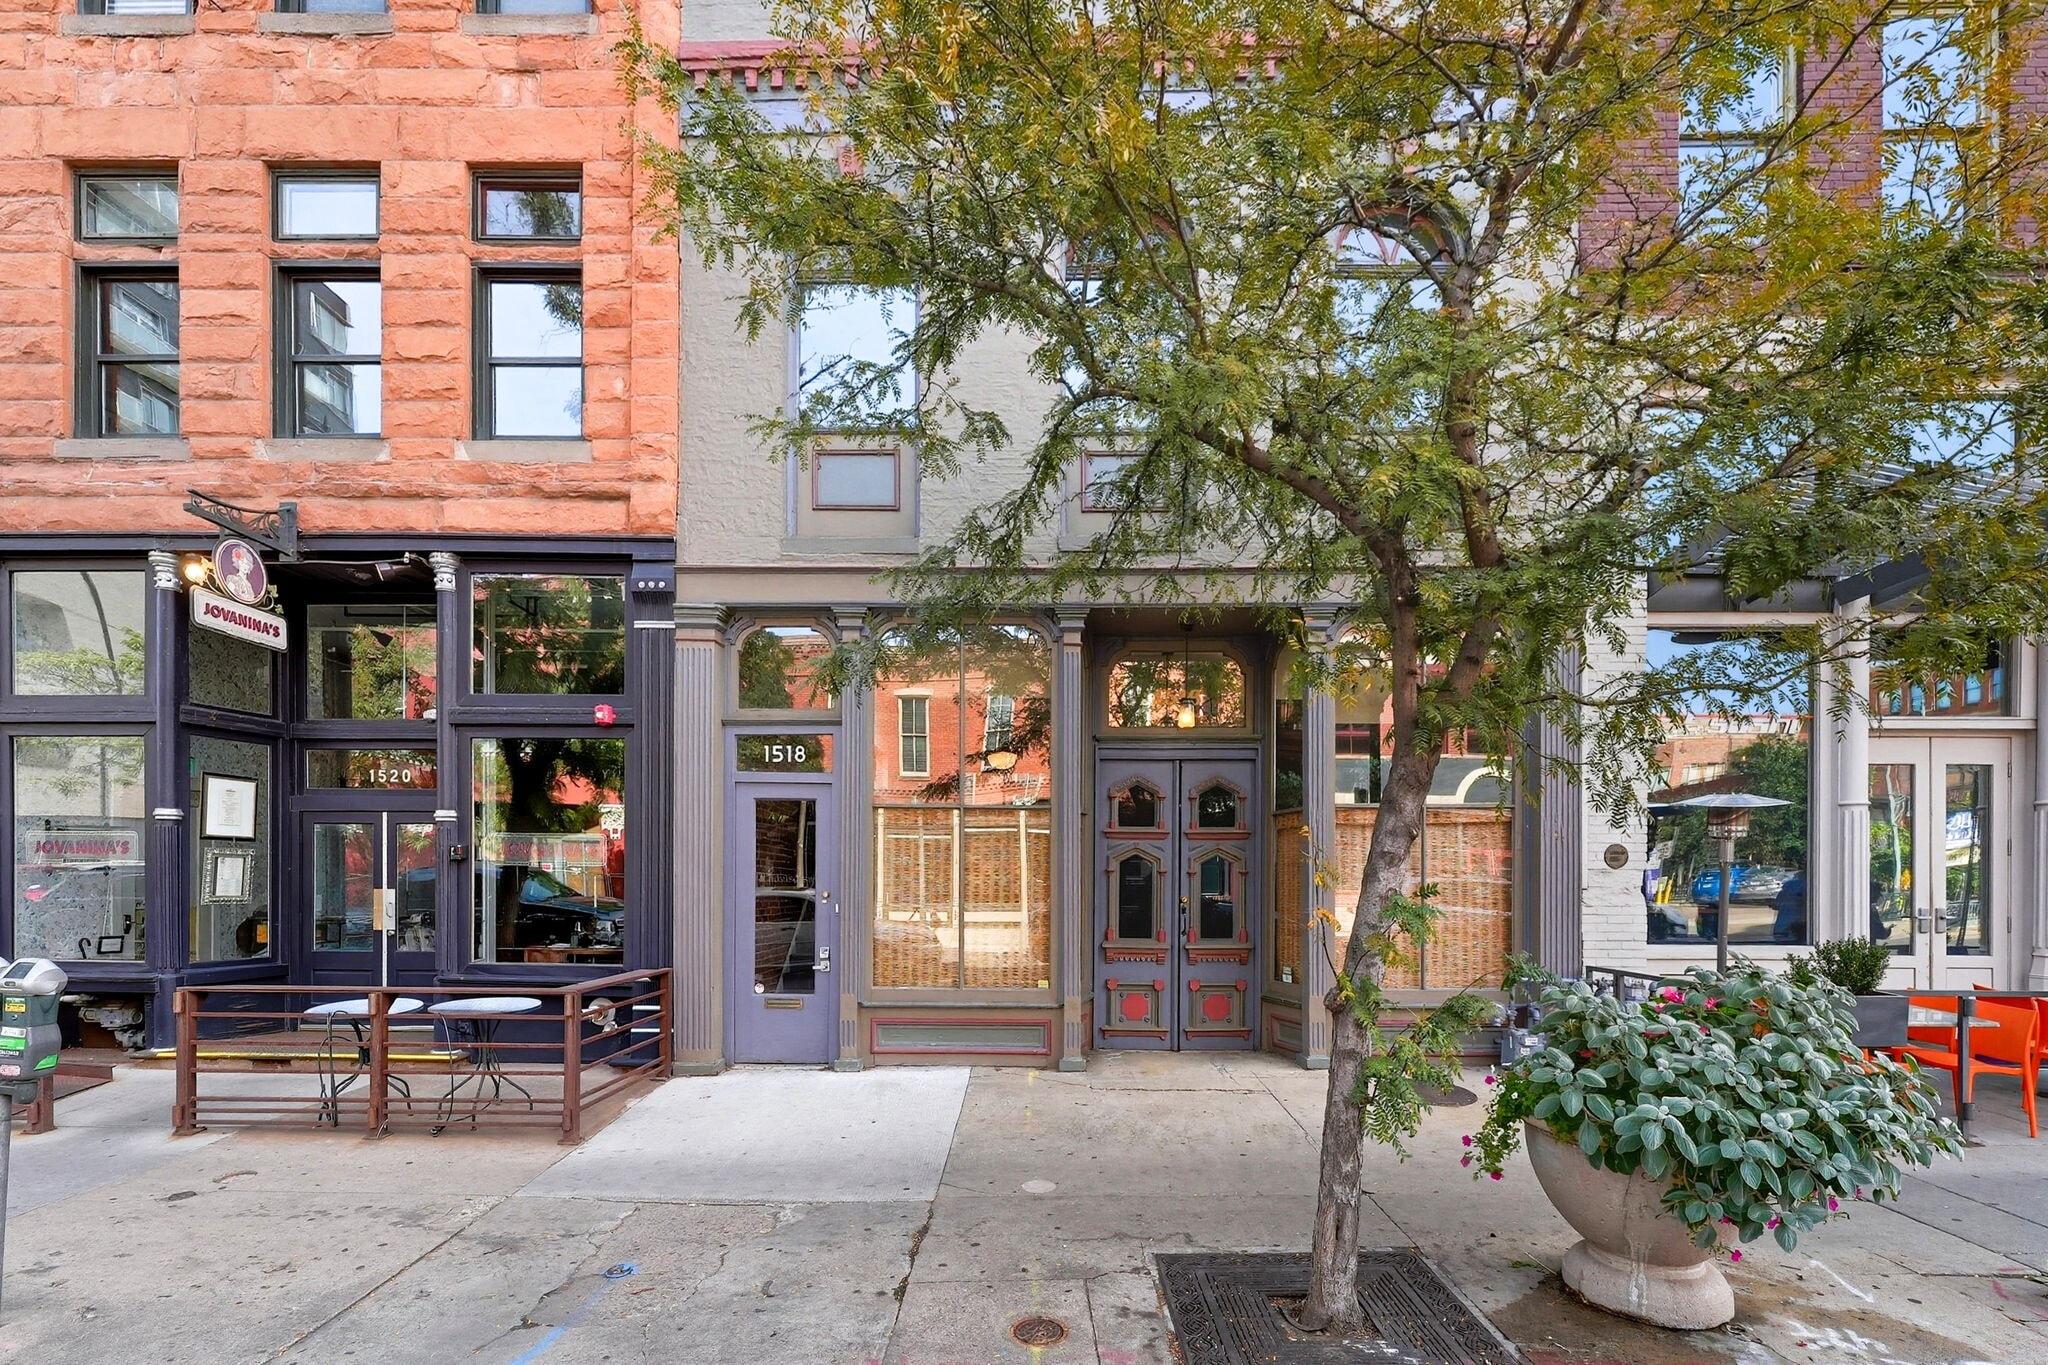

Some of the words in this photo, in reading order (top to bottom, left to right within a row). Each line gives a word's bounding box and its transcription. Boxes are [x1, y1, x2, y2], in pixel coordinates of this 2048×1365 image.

[203, 602, 281, 638] JOVANINA'S
[764, 745, 806, 763] 1518
[369, 769, 411, 783] 1520
